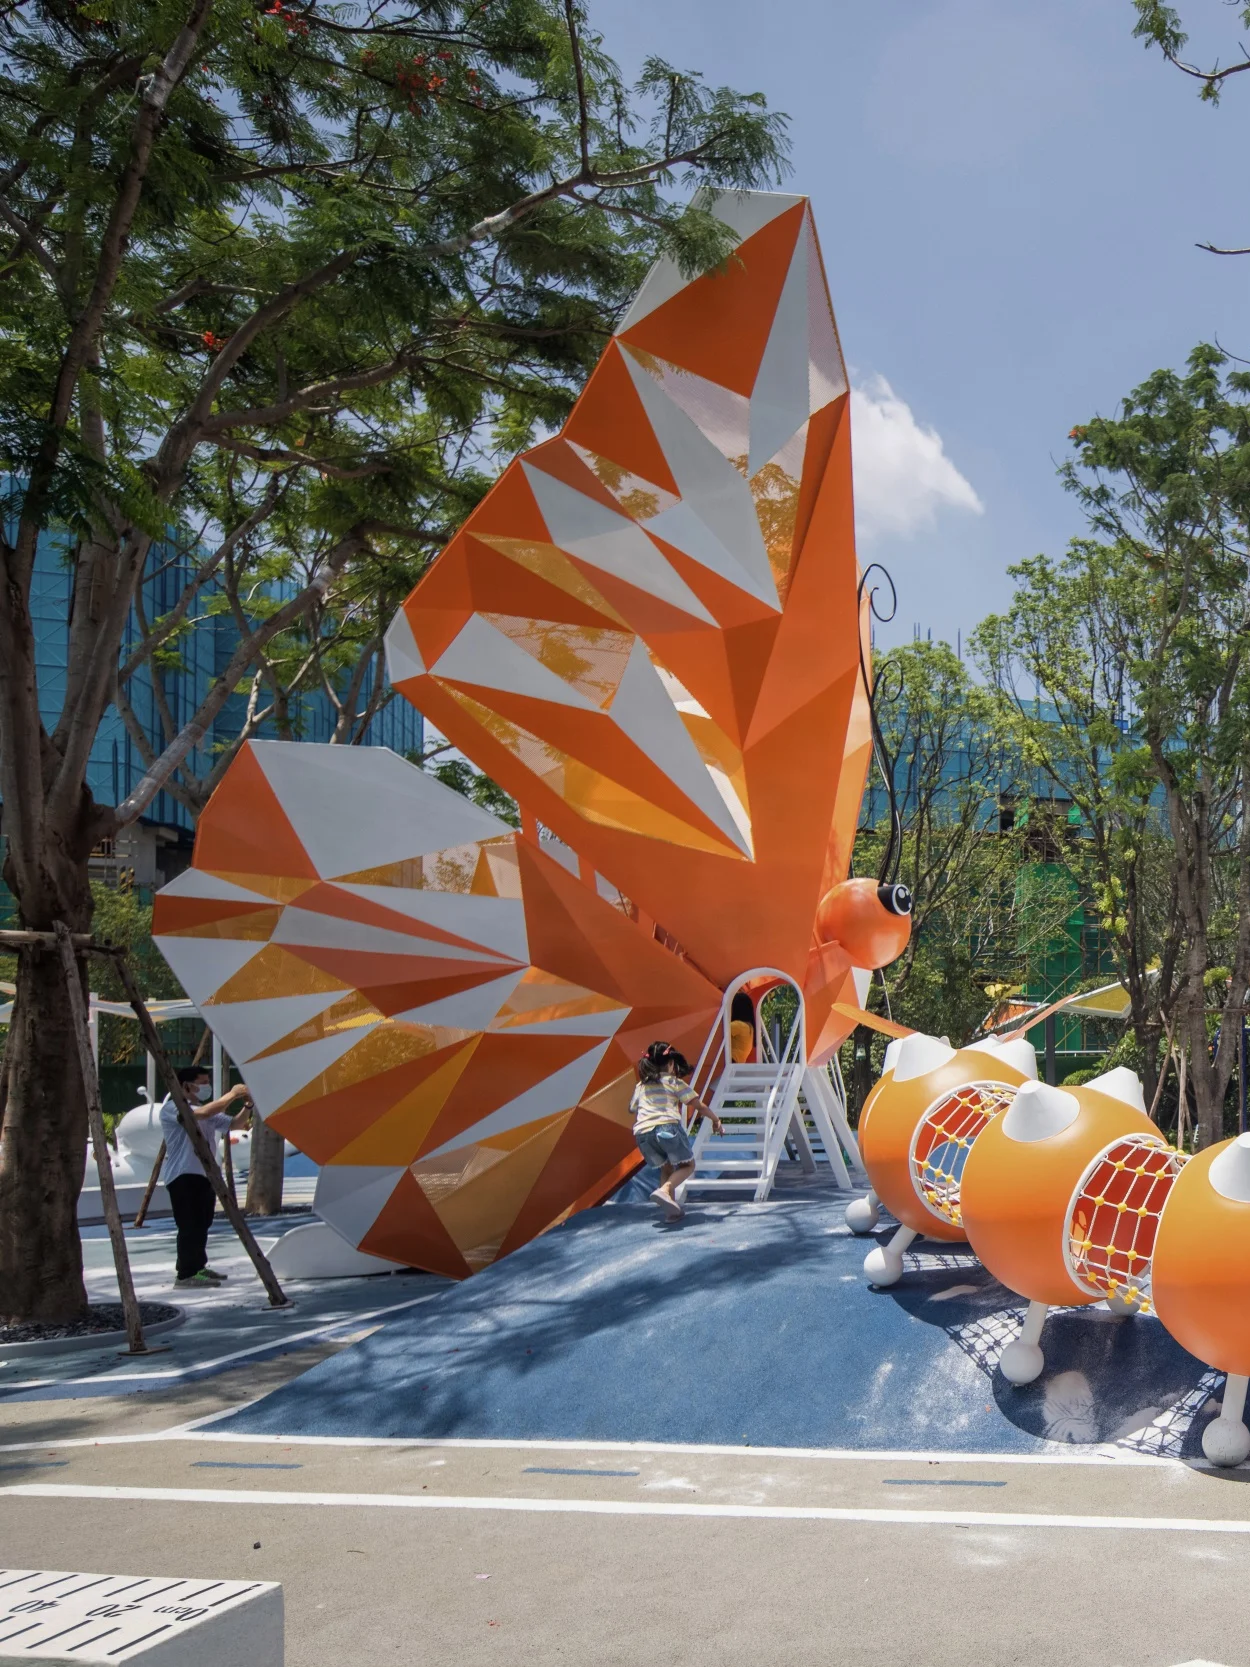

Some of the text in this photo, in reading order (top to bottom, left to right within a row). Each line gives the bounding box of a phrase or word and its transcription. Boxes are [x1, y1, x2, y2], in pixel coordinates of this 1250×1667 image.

[8, 1599, 209, 1621] 0cm 20 40
